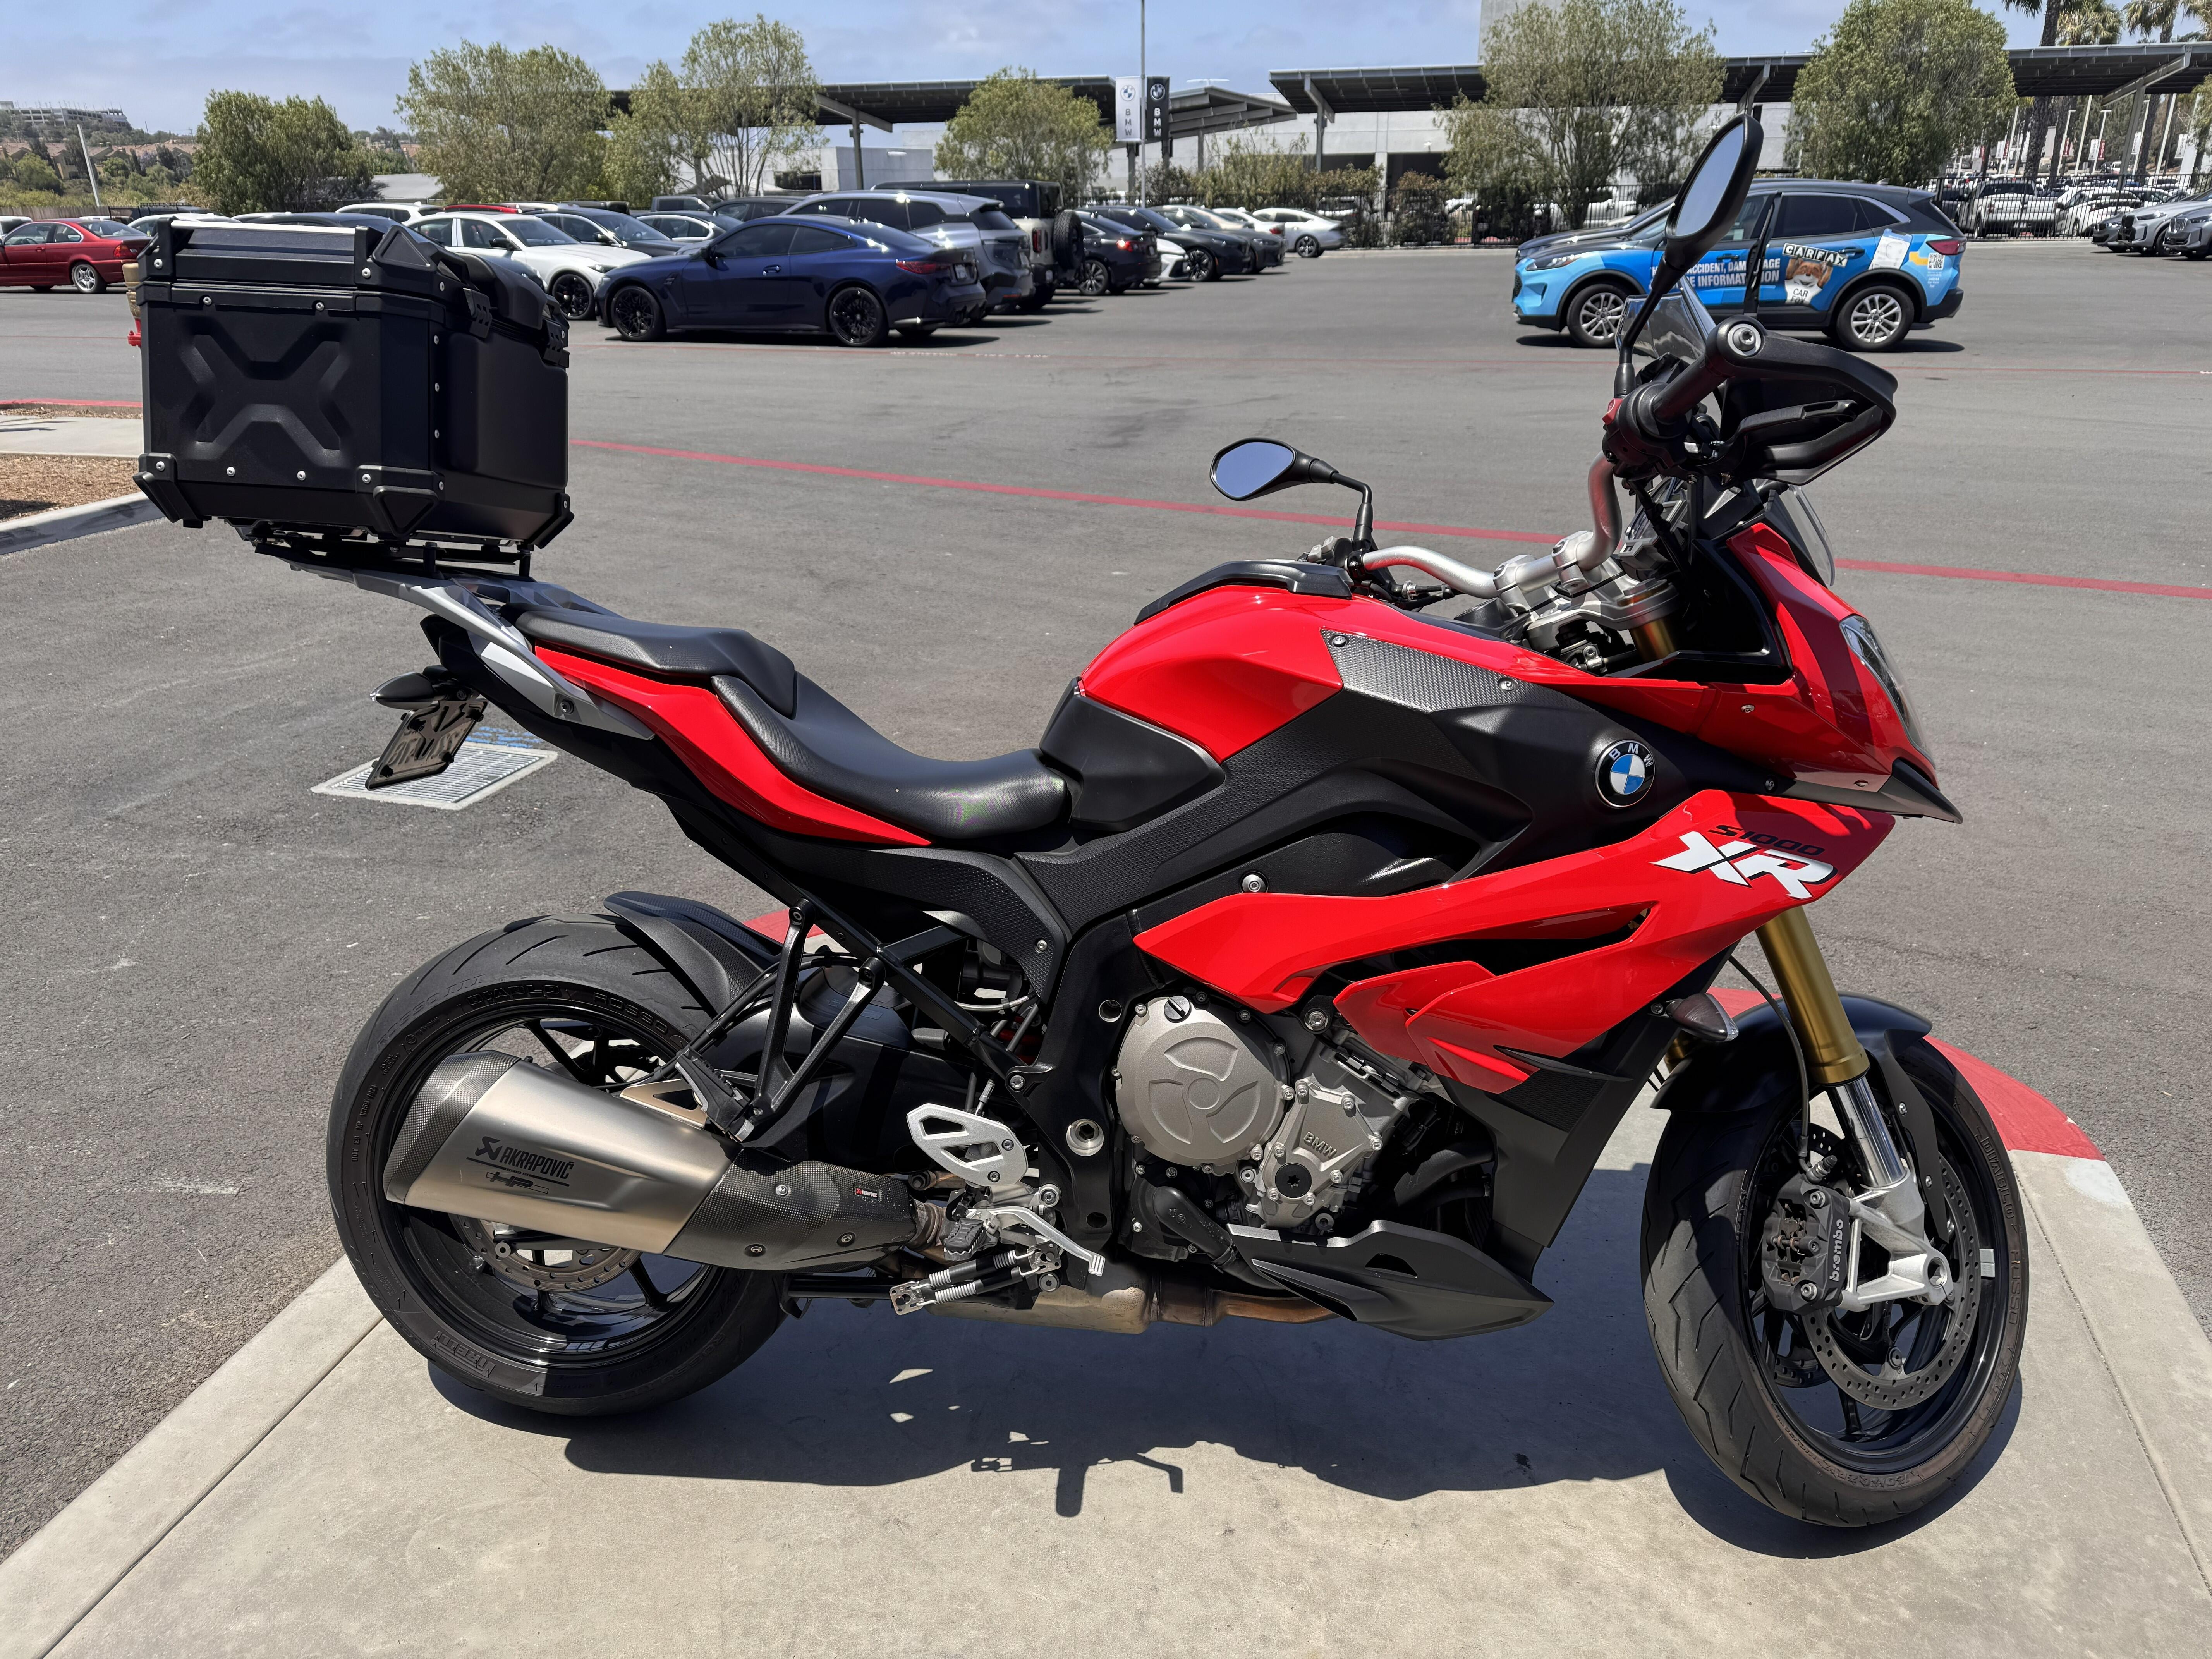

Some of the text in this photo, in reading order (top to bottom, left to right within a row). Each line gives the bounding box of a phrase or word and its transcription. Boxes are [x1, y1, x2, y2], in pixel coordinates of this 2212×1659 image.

[1153, 108, 1161, 136] BMW
[1785, 245, 1846, 265] CARFAX
[1793, 288, 1808, 297] CAR
[1609, 743, 1653, 767] BMW
[1707, 825, 1825, 856] S1000
[1648, 831, 1836, 899] XR
[465, 984, 668, 1033] DIABLO ROSSO
[1303, 1131, 1337, 1157] BMW
[499, 1147, 575, 1179] AKRAPOVIČ
[489, 1172, 534, 1187] HP
[1980, 1137, 2021, 1325] DIABLO ROSSO
[1829, 1219, 1844, 1282] brembo
[429, 1330, 496, 1378] PIRELLI
